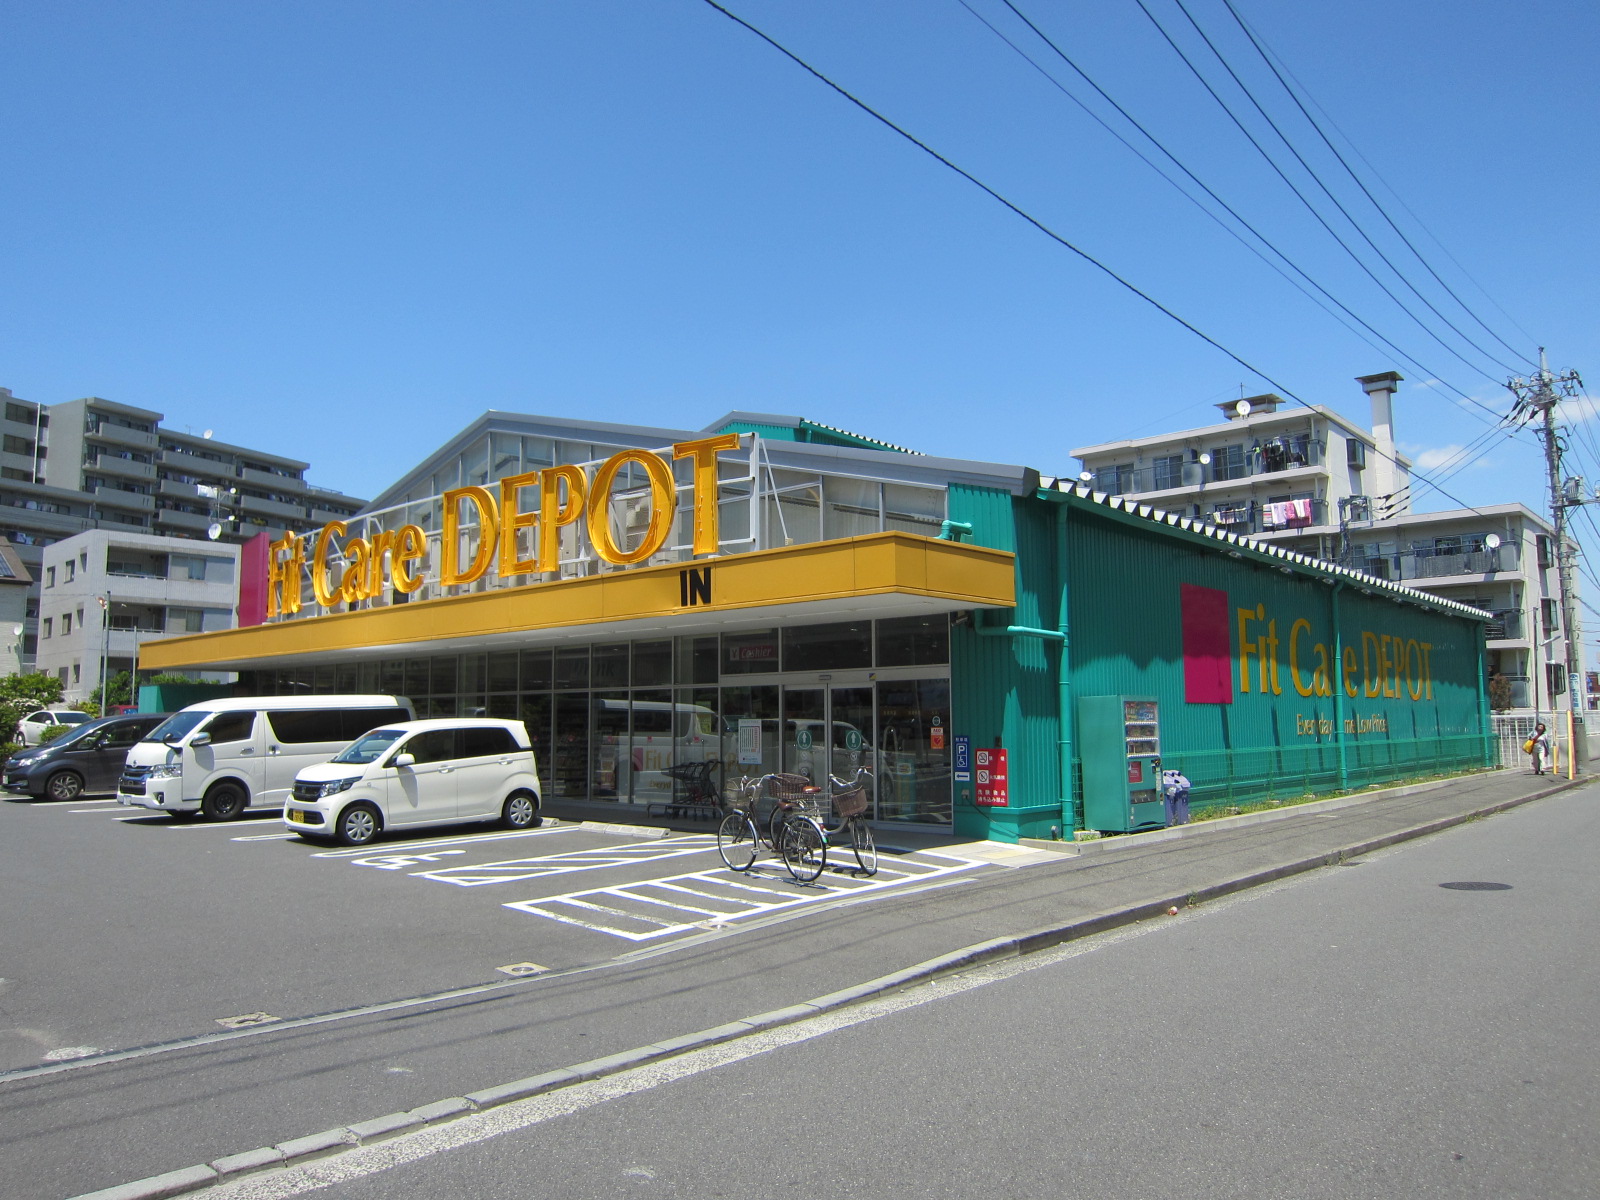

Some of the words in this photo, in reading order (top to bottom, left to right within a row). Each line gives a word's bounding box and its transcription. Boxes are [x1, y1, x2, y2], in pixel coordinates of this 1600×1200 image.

[267, 530, 307, 617] Fit
[312, 520, 427, 607] Care
[440, 433, 740, 586] DEPOT
[680, 567, 712, 607] IN
[741, 646, 772, 659] Cashier
[1237, 603, 1282, 695] Fit
[1289, 618, 1358, 698] Cae
[1362, 630, 1432, 701] DEPOT
[958, 745, 965, 754] P
